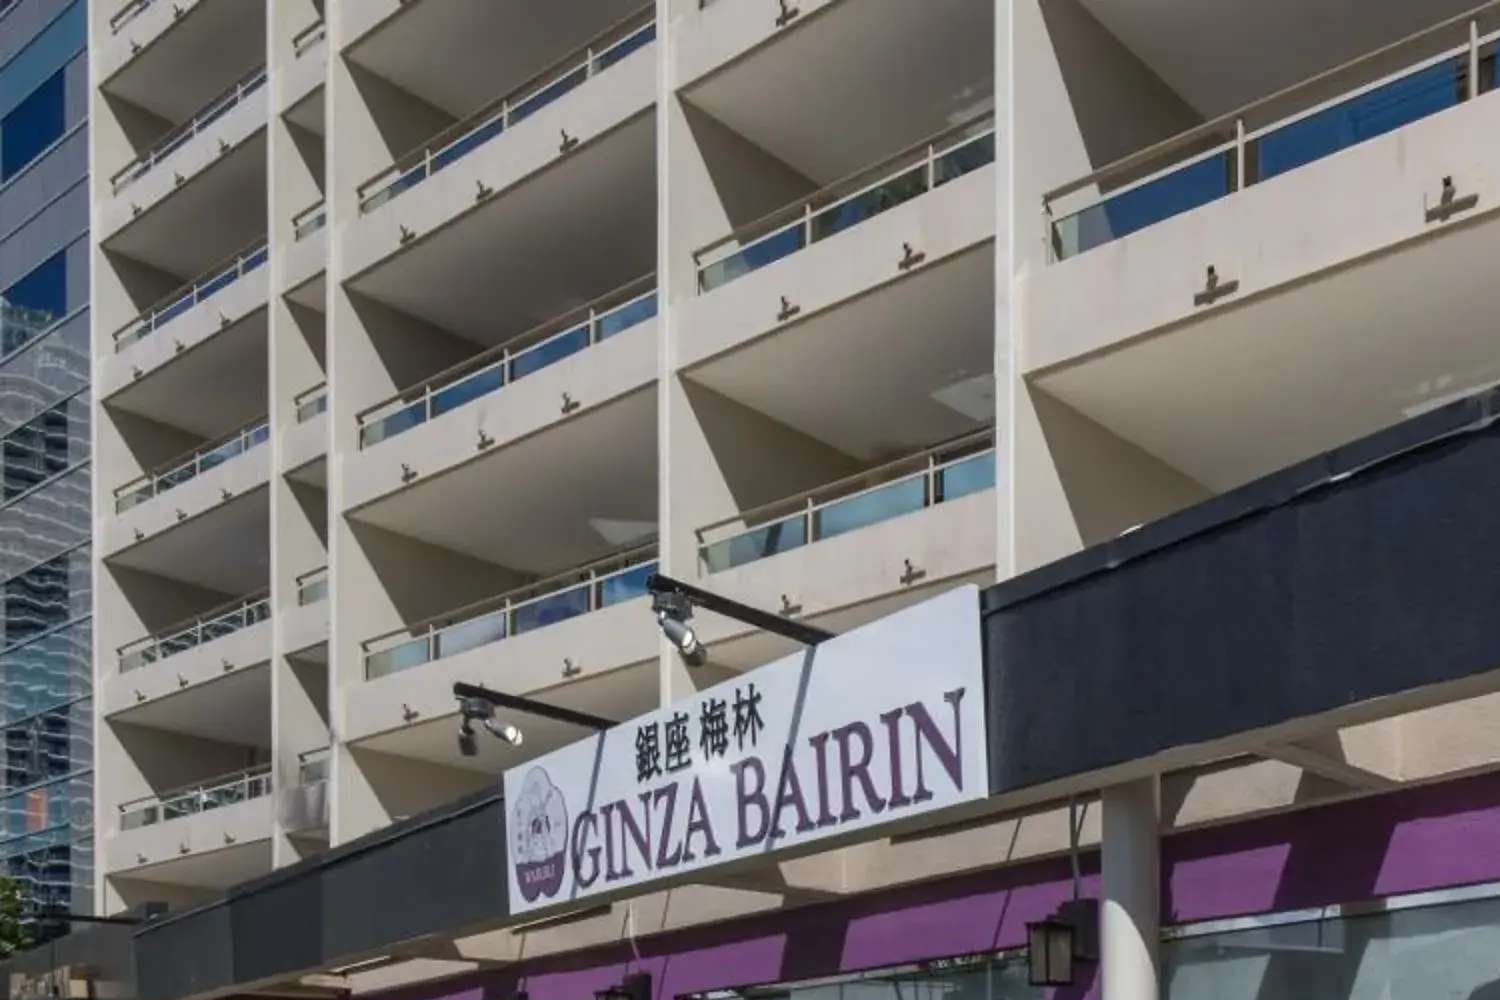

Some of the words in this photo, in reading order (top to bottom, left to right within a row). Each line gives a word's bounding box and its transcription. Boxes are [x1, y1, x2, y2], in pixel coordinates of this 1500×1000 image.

[571, 775, 721, 889] GINZA
[730, 687, 966, 850] BAIRIN
[635, 683, 765, 783] 銀座梅林
